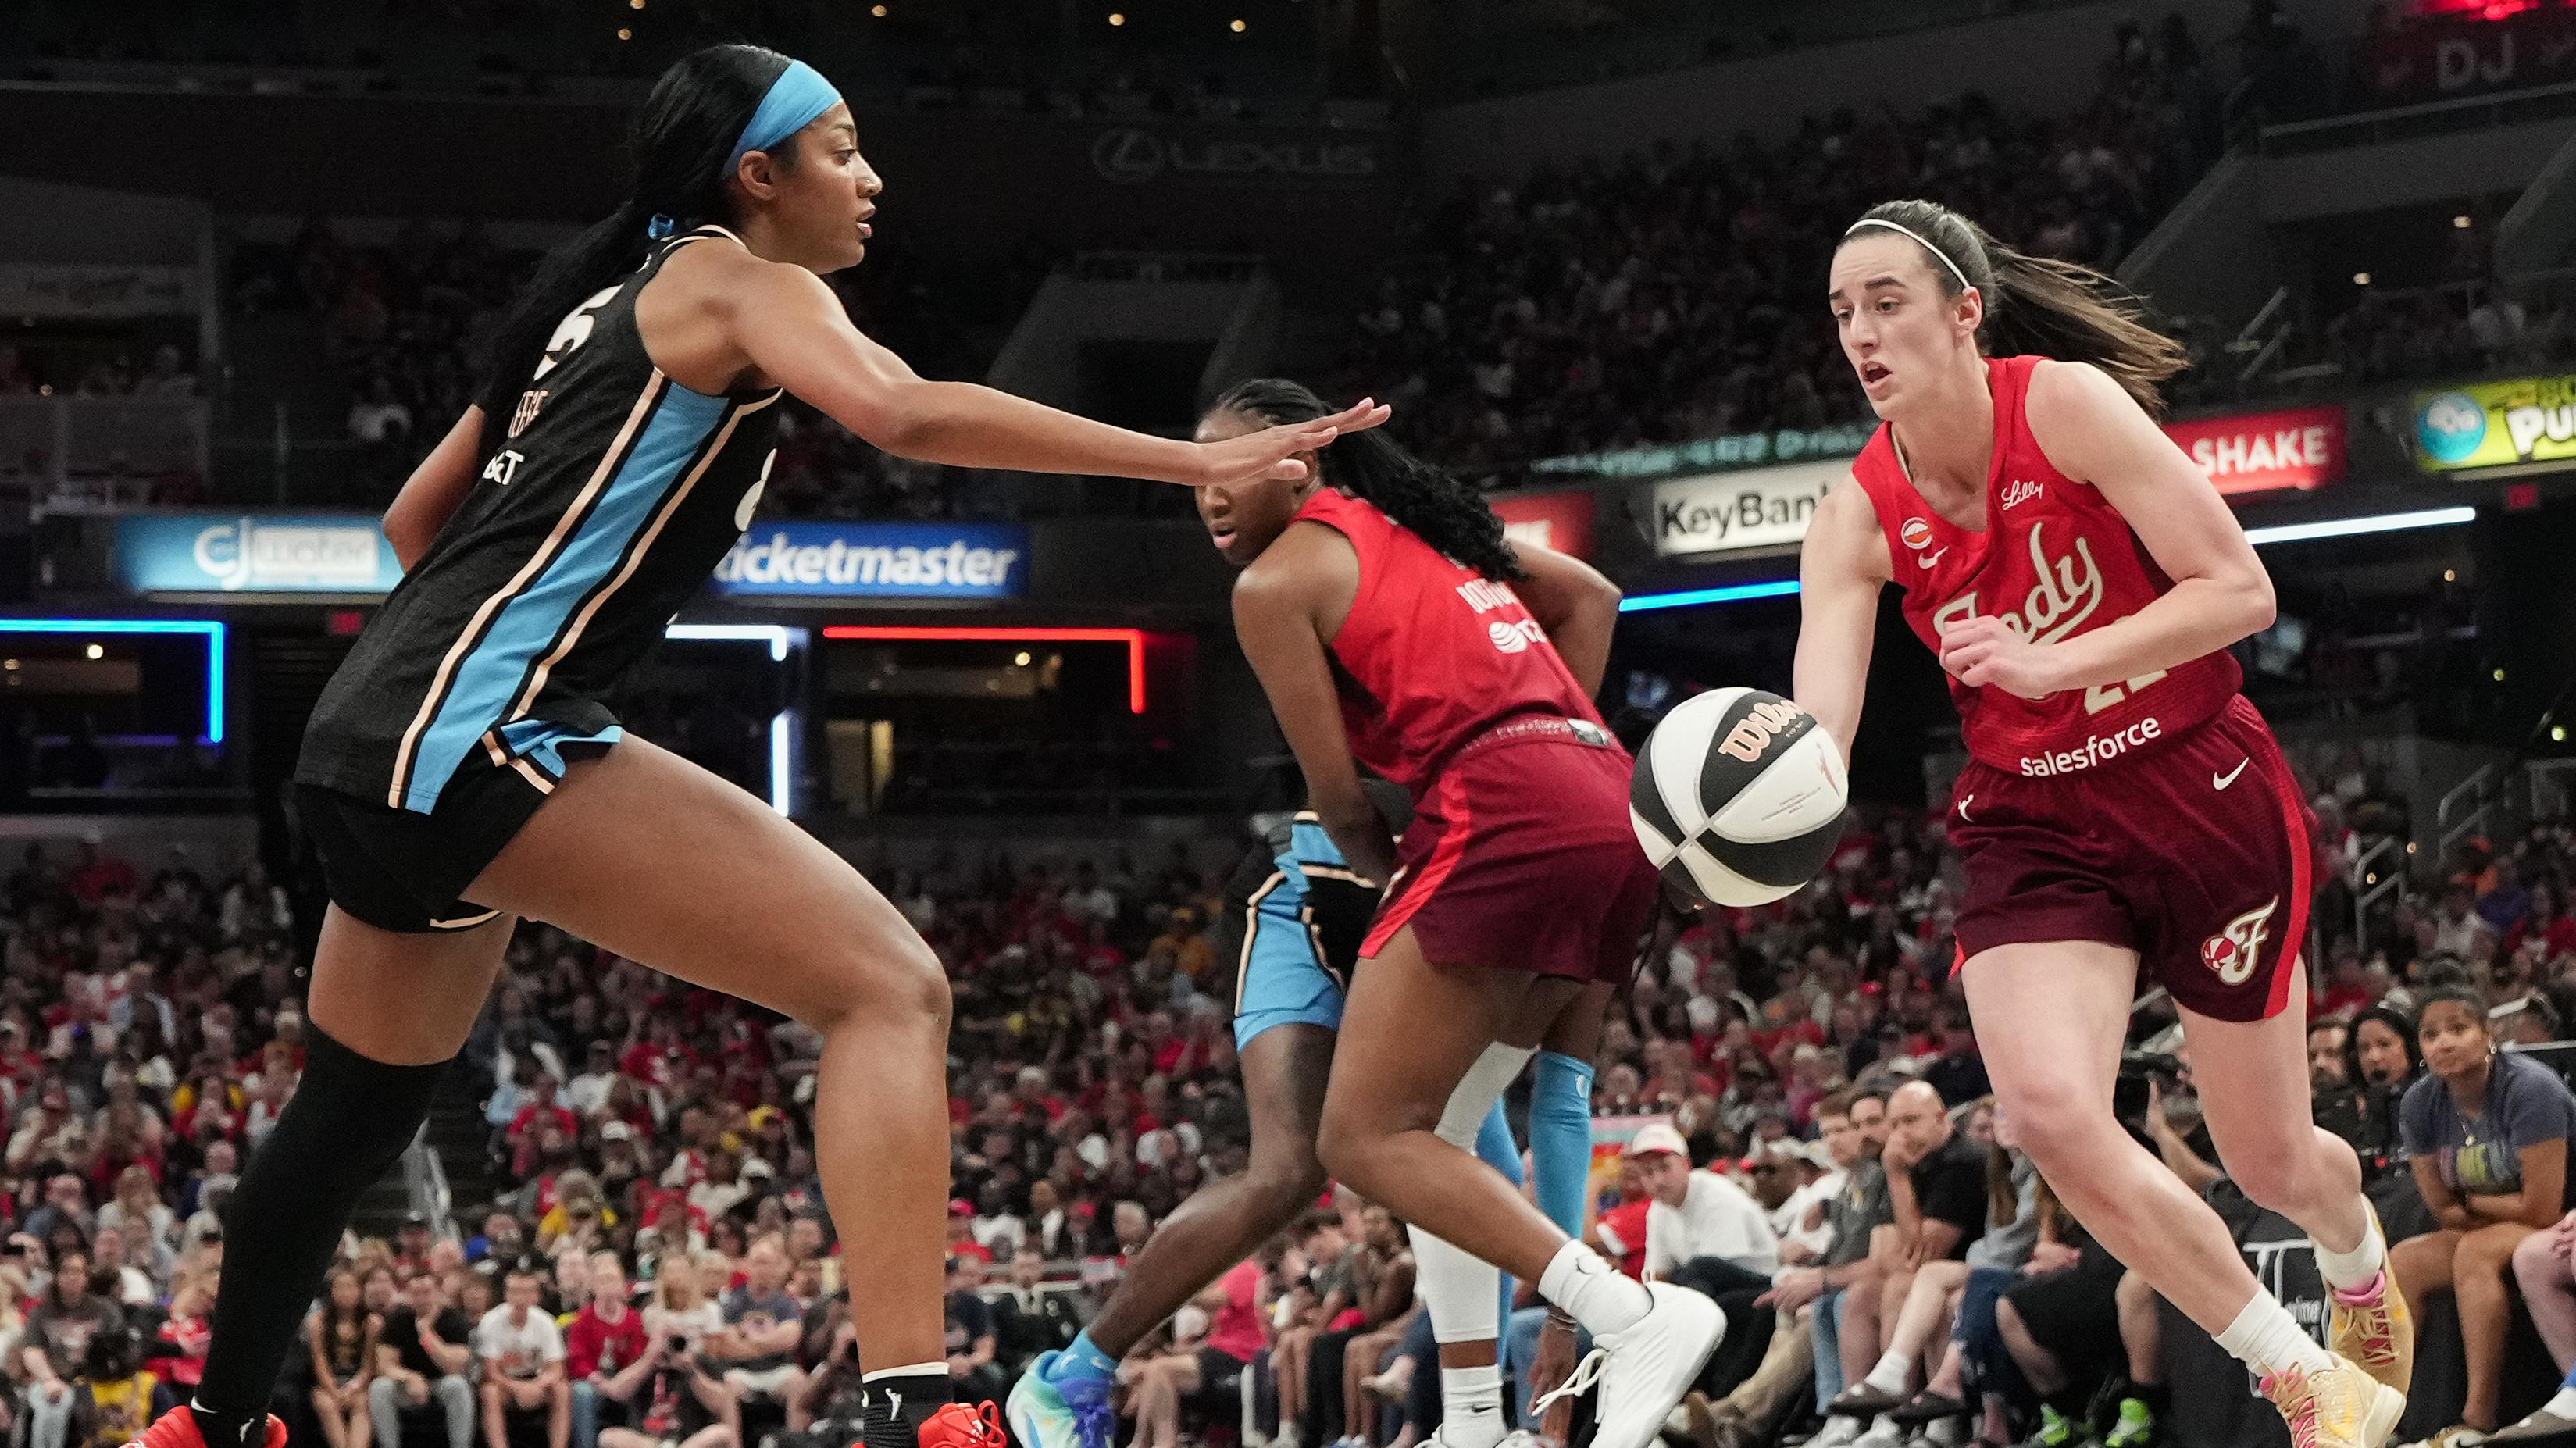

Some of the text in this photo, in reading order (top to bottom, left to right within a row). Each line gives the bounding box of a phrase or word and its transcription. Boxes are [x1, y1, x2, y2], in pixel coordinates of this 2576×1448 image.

[2437, 32, 2514, 89] DJ
[1170, 141, 1376, 175] LEXUS
[2192, 426, 2328, 476] SHAKE
[2001, 480, 2043, 511] Lilly
[1718, 699, 1804, 762] Wilso
[2021, 717, 2161, 777] salesforce
